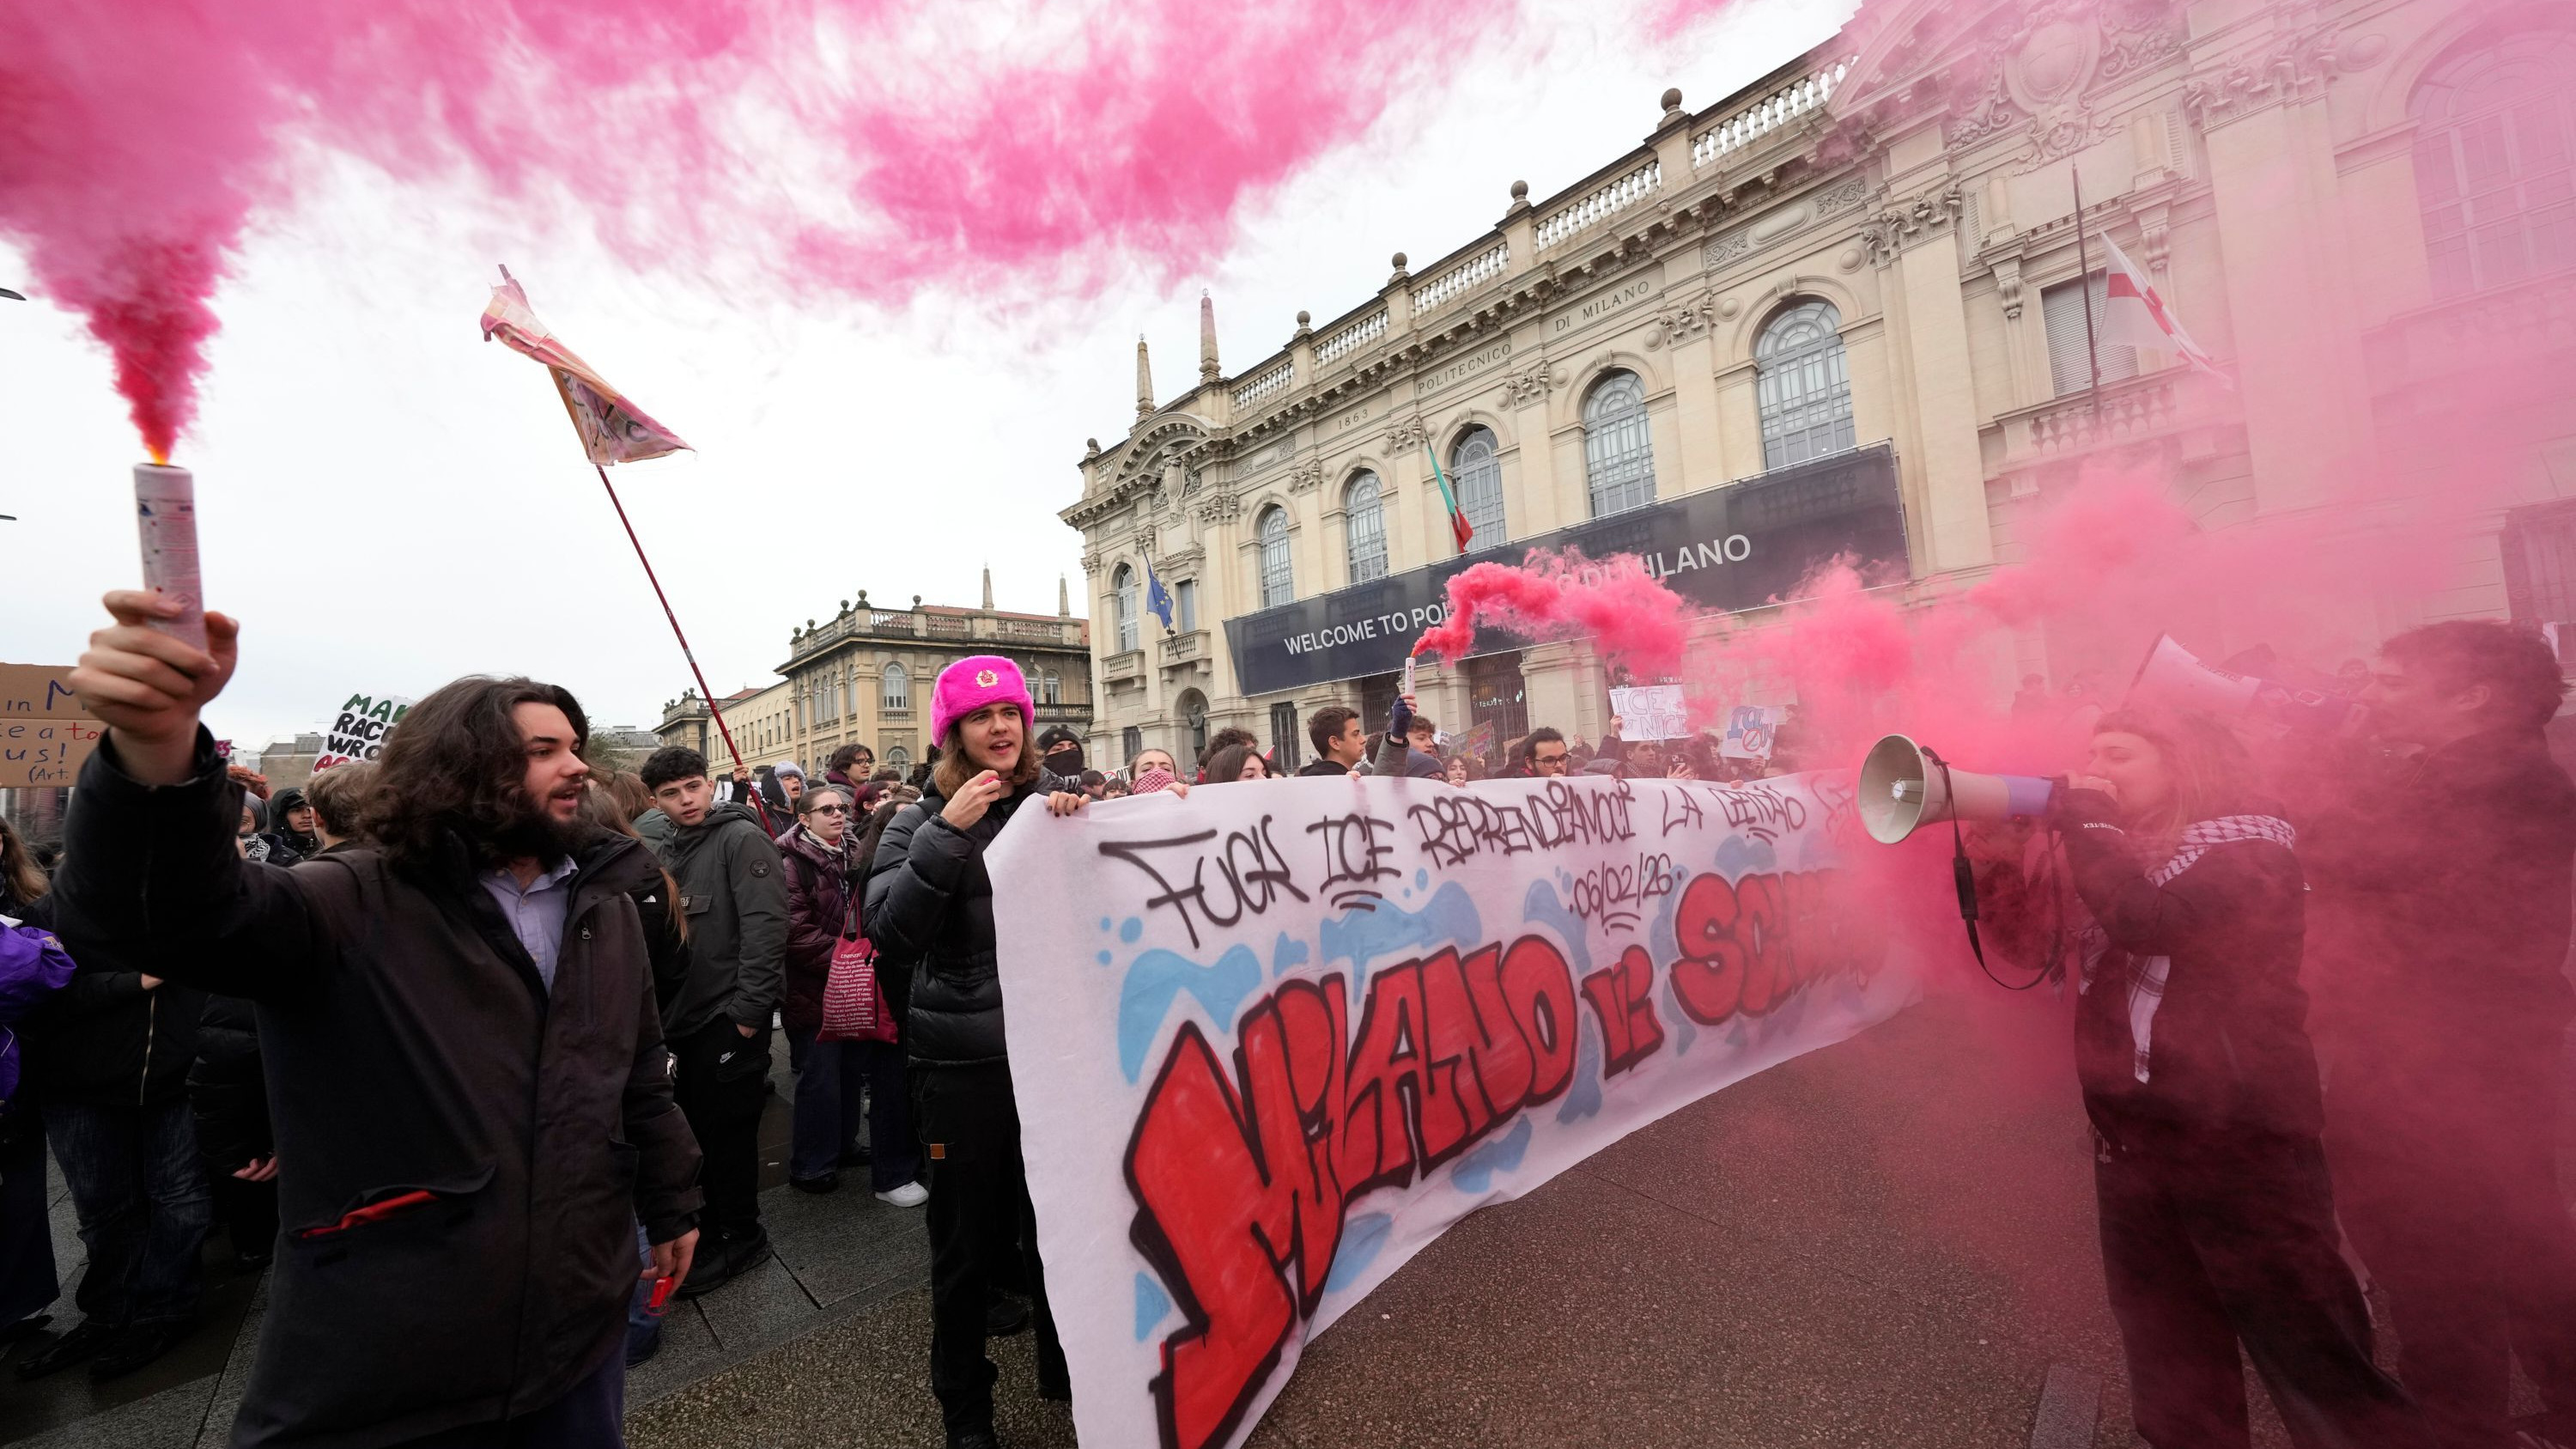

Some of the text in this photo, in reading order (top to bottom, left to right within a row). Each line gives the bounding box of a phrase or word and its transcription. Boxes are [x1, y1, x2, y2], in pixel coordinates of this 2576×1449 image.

[1417, 280, 1650, 394] POLITECNICO DI MILANO
[1338, 409, 1369, 430] 1863
[1284, 618, 1377, 655] WELCOME
[1378, 612, 1408, 636] TO
[1611, 688, 1664, 715] ICE
[39, 727, 53, 740] a
[1097, 813, 1310, 949] FUCK
[1305, 813, 1402, 894] ICE
[1662, 784, 1704, 838] LA
[1122, 933, 1578, 1449] MILANO
